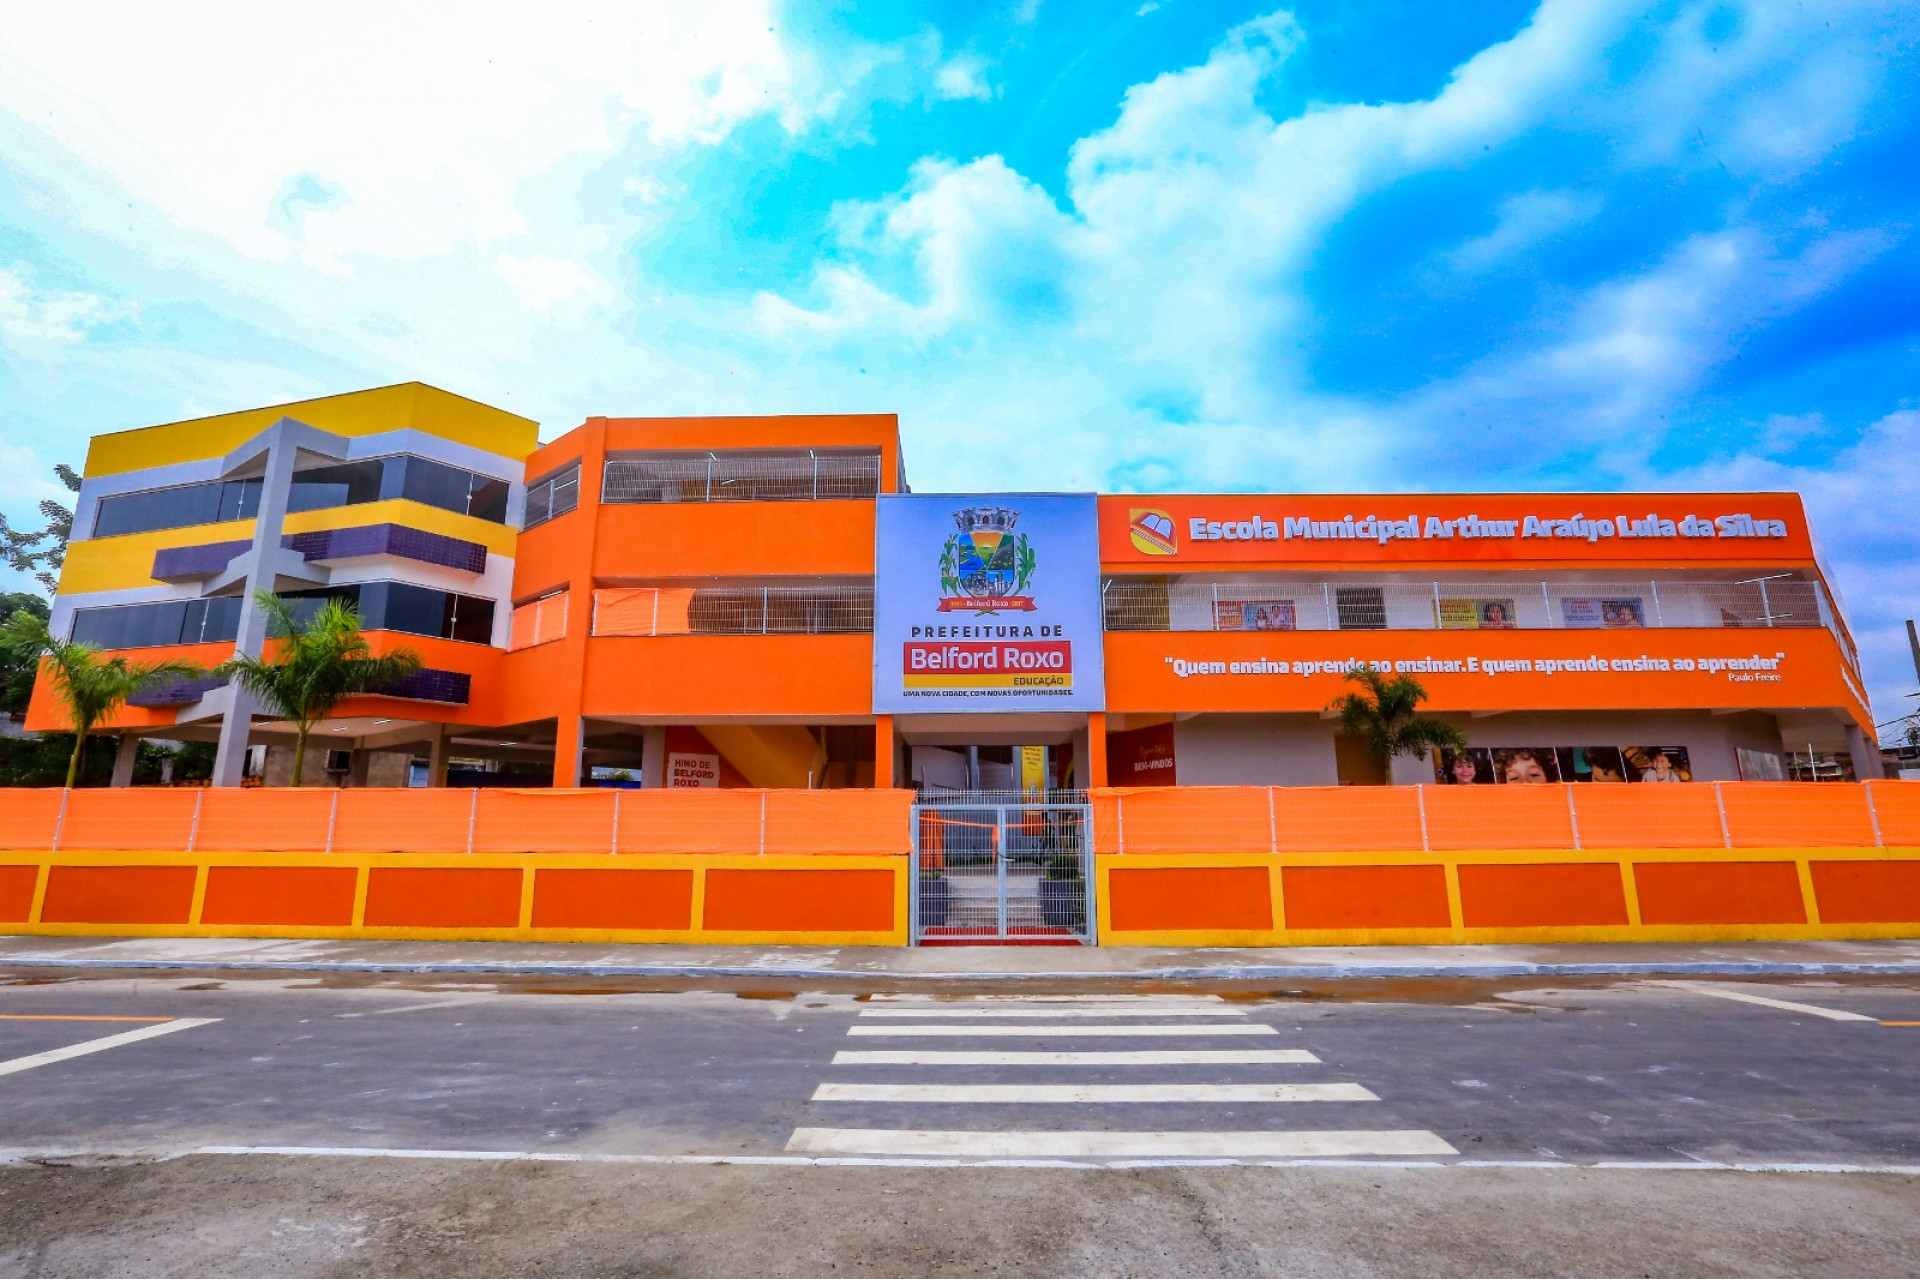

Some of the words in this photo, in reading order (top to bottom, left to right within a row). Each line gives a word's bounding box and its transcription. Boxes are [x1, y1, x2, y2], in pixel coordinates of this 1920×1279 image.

[1189, 515, 1279, 541] Escola
[1283, 515, 1420, 545] Municipal
[1423, 514, 1518, 539] Arthur
[1521, 512, 1615, 542] Araújo
[1615, 513, 1677, 538] Lula
[1678, 514, 1715, 538] da
[1715, 513, 1788, 538] Silva
[911, 626, 1034, 638] PREFEITURA
[1040, 625, 1063, 637] DE
[911, 646, 998, 670] Belford
[1003, 647, 1064, 669] Roxo
[1229, 656, 1290, 675] ensina
[1292, 656, 1367, 677] aprende
[1369, 660, 1392, 673] ao
[1481, 659, 1532, 676] quem
[1535, 654, 1609, 675] aprende
[1611, 654, 1670, 672] ensina
[1673, 658, 1696, 672] ao
[1013, 675, 1064, 687] EDUCAÇÃO
[1727, 672, 1754, 682] Paulo
[1755, 672, 1781, 681] Freire
[987, 689, 1012, 697] NOVAS
[675, 759, 697, 768] HINO
[699, 761, 711, 769] DE
[674, 769, 714, 779] BELFORD
[674, 778, 699, 788] ROXO
